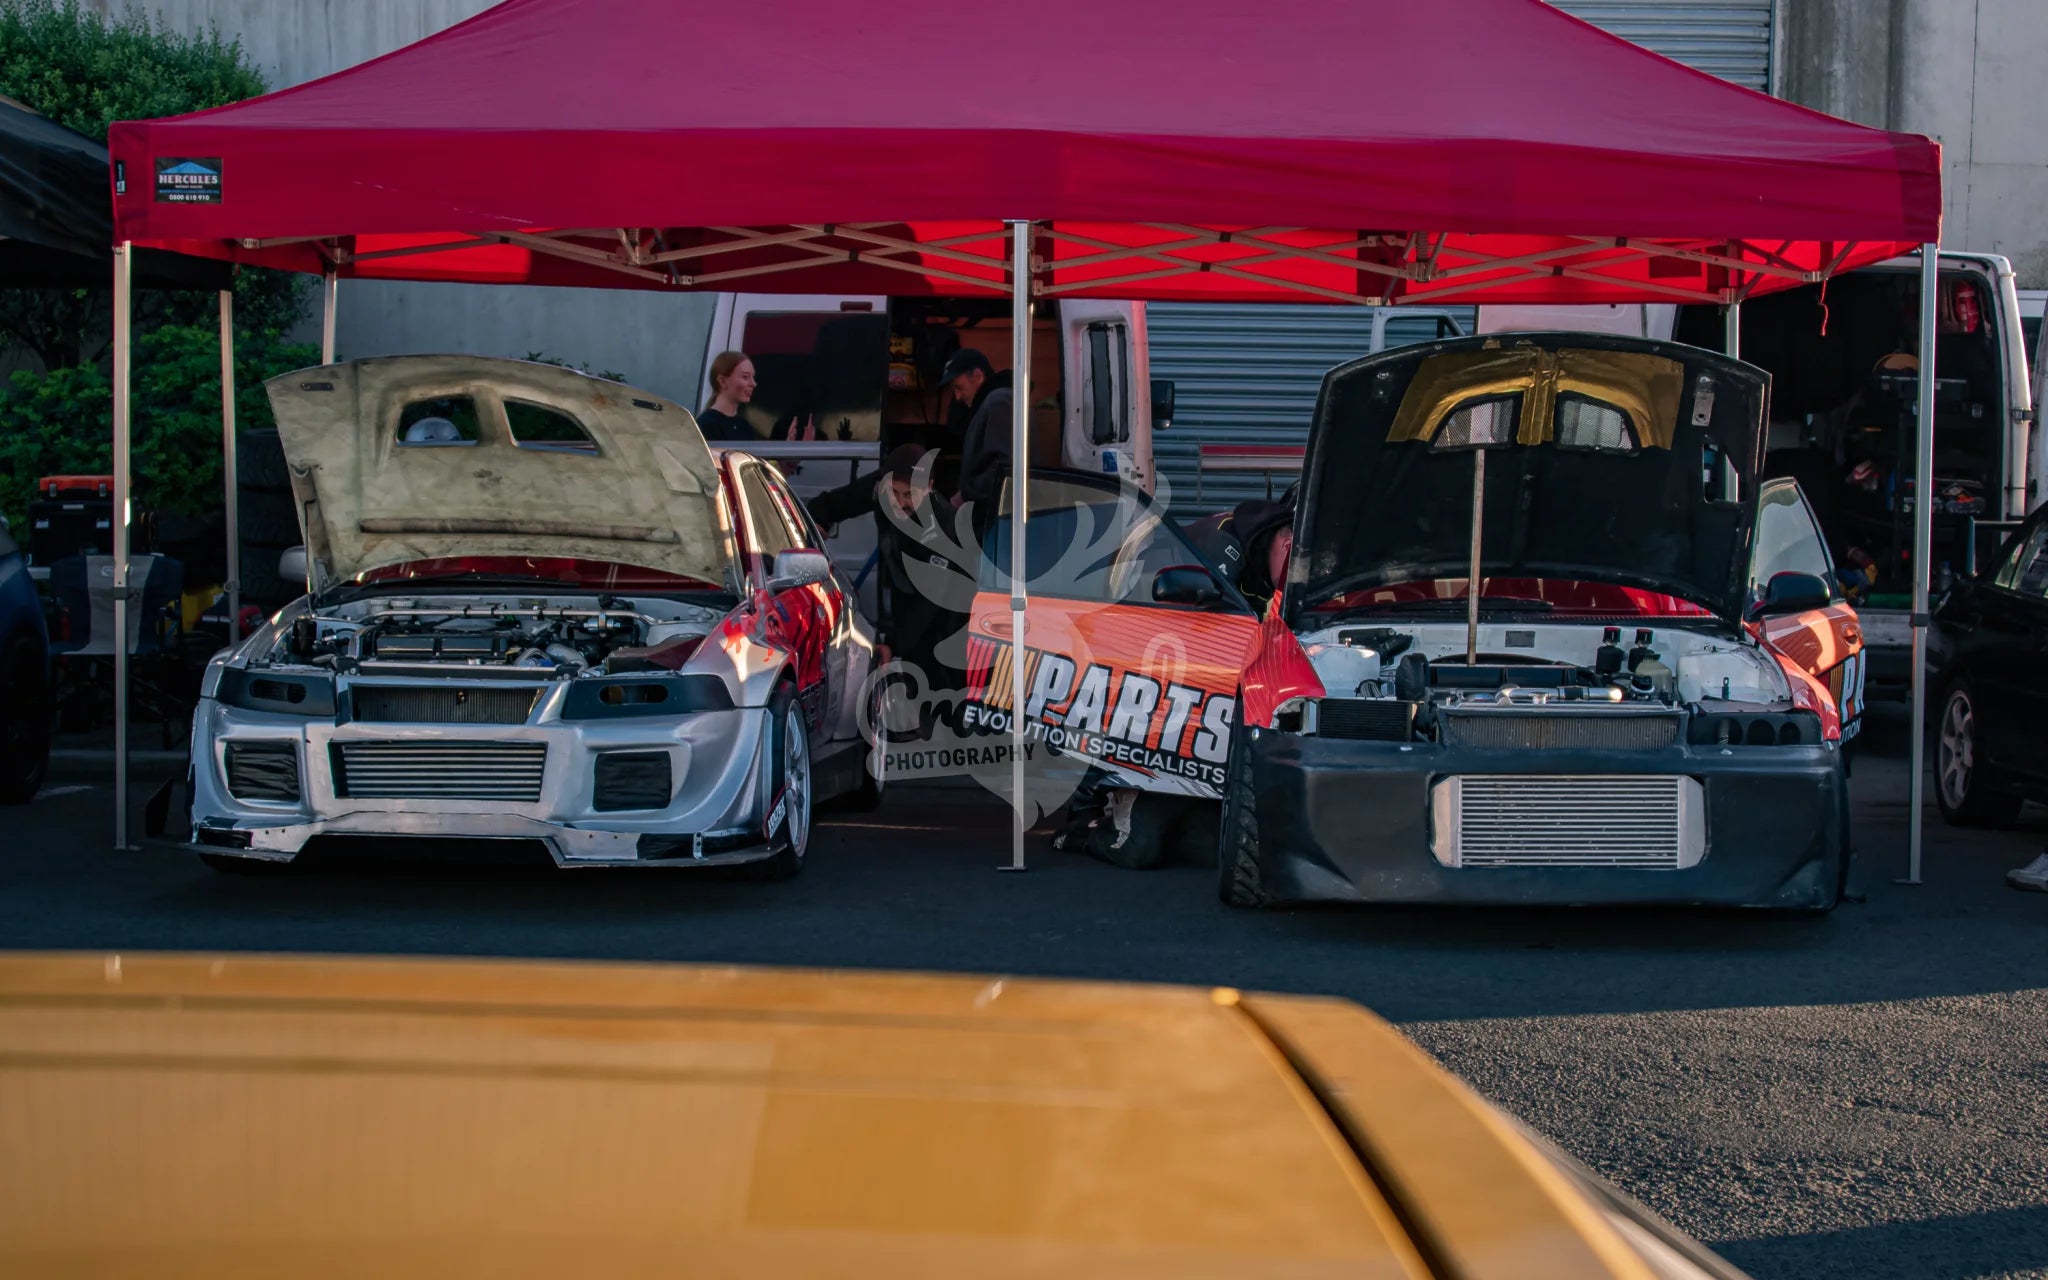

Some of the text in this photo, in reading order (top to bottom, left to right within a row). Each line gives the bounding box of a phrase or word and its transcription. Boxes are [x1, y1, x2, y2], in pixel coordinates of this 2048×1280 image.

[159, 174, 218, 184] HERCULES
[964, 704, 1225, 784] EVOLUTION SPECIALISTS
[1026, 653, 1235, 763] PARTS
